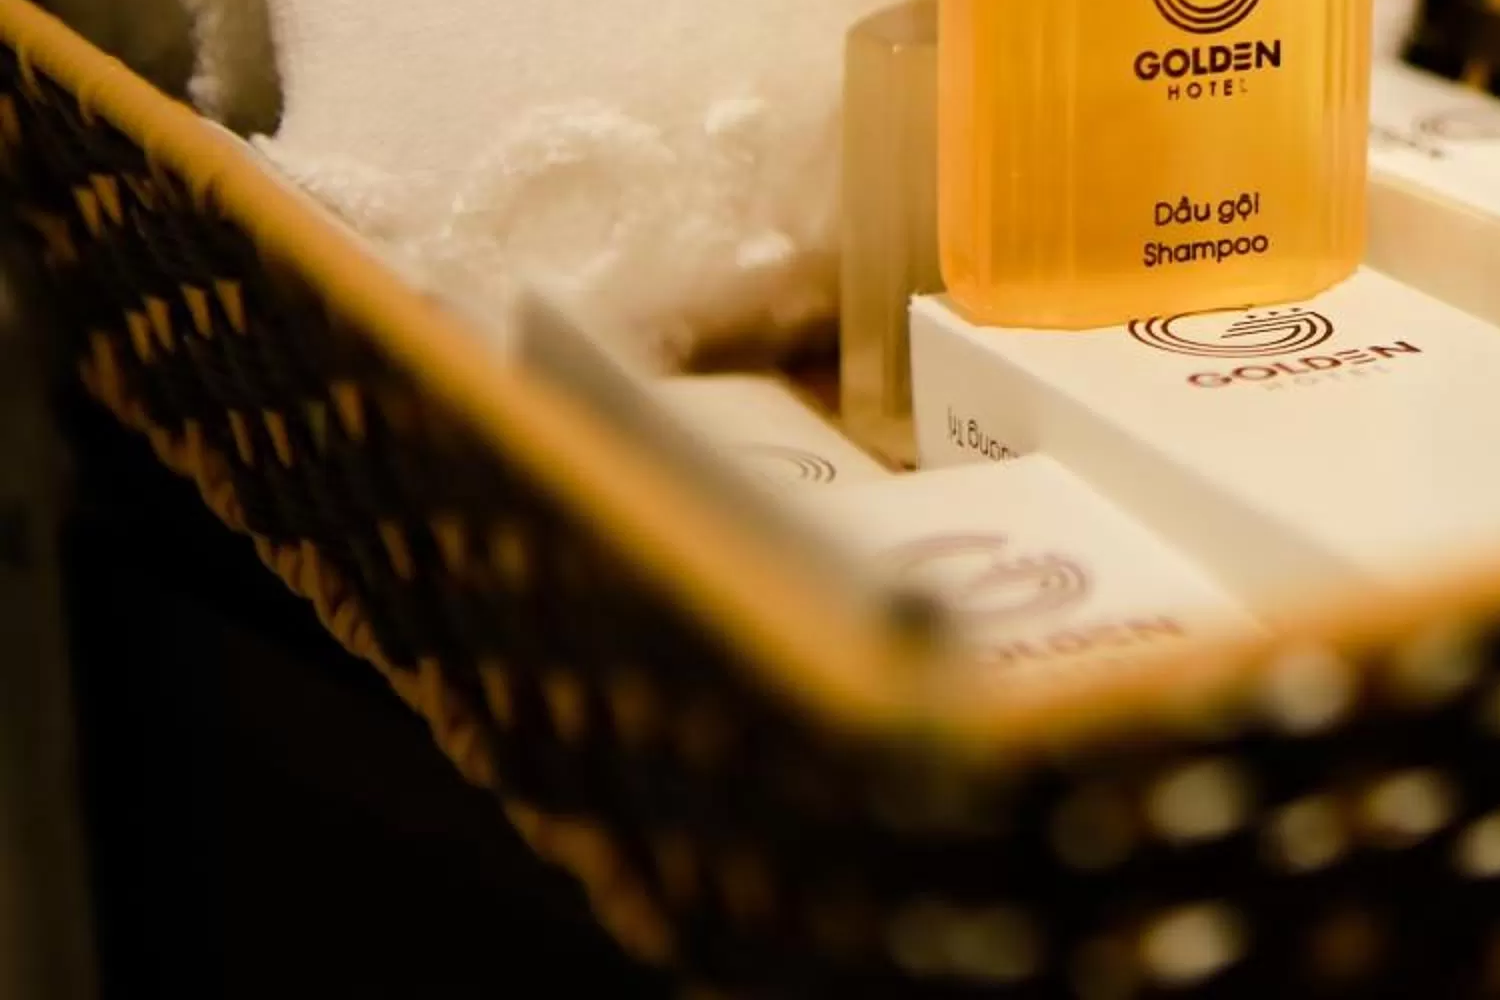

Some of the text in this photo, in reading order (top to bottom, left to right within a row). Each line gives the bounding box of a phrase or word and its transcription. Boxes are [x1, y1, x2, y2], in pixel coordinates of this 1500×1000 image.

[1133, 39, 1281, 81] GOLDEN
[1167, 78, 1249, 101] HOTEL
[1217, 191, 1260, 225] gội
[1143, 234, 1269, 268] Shampoo
[1186, 340, 1422, 389] GOLDEN
